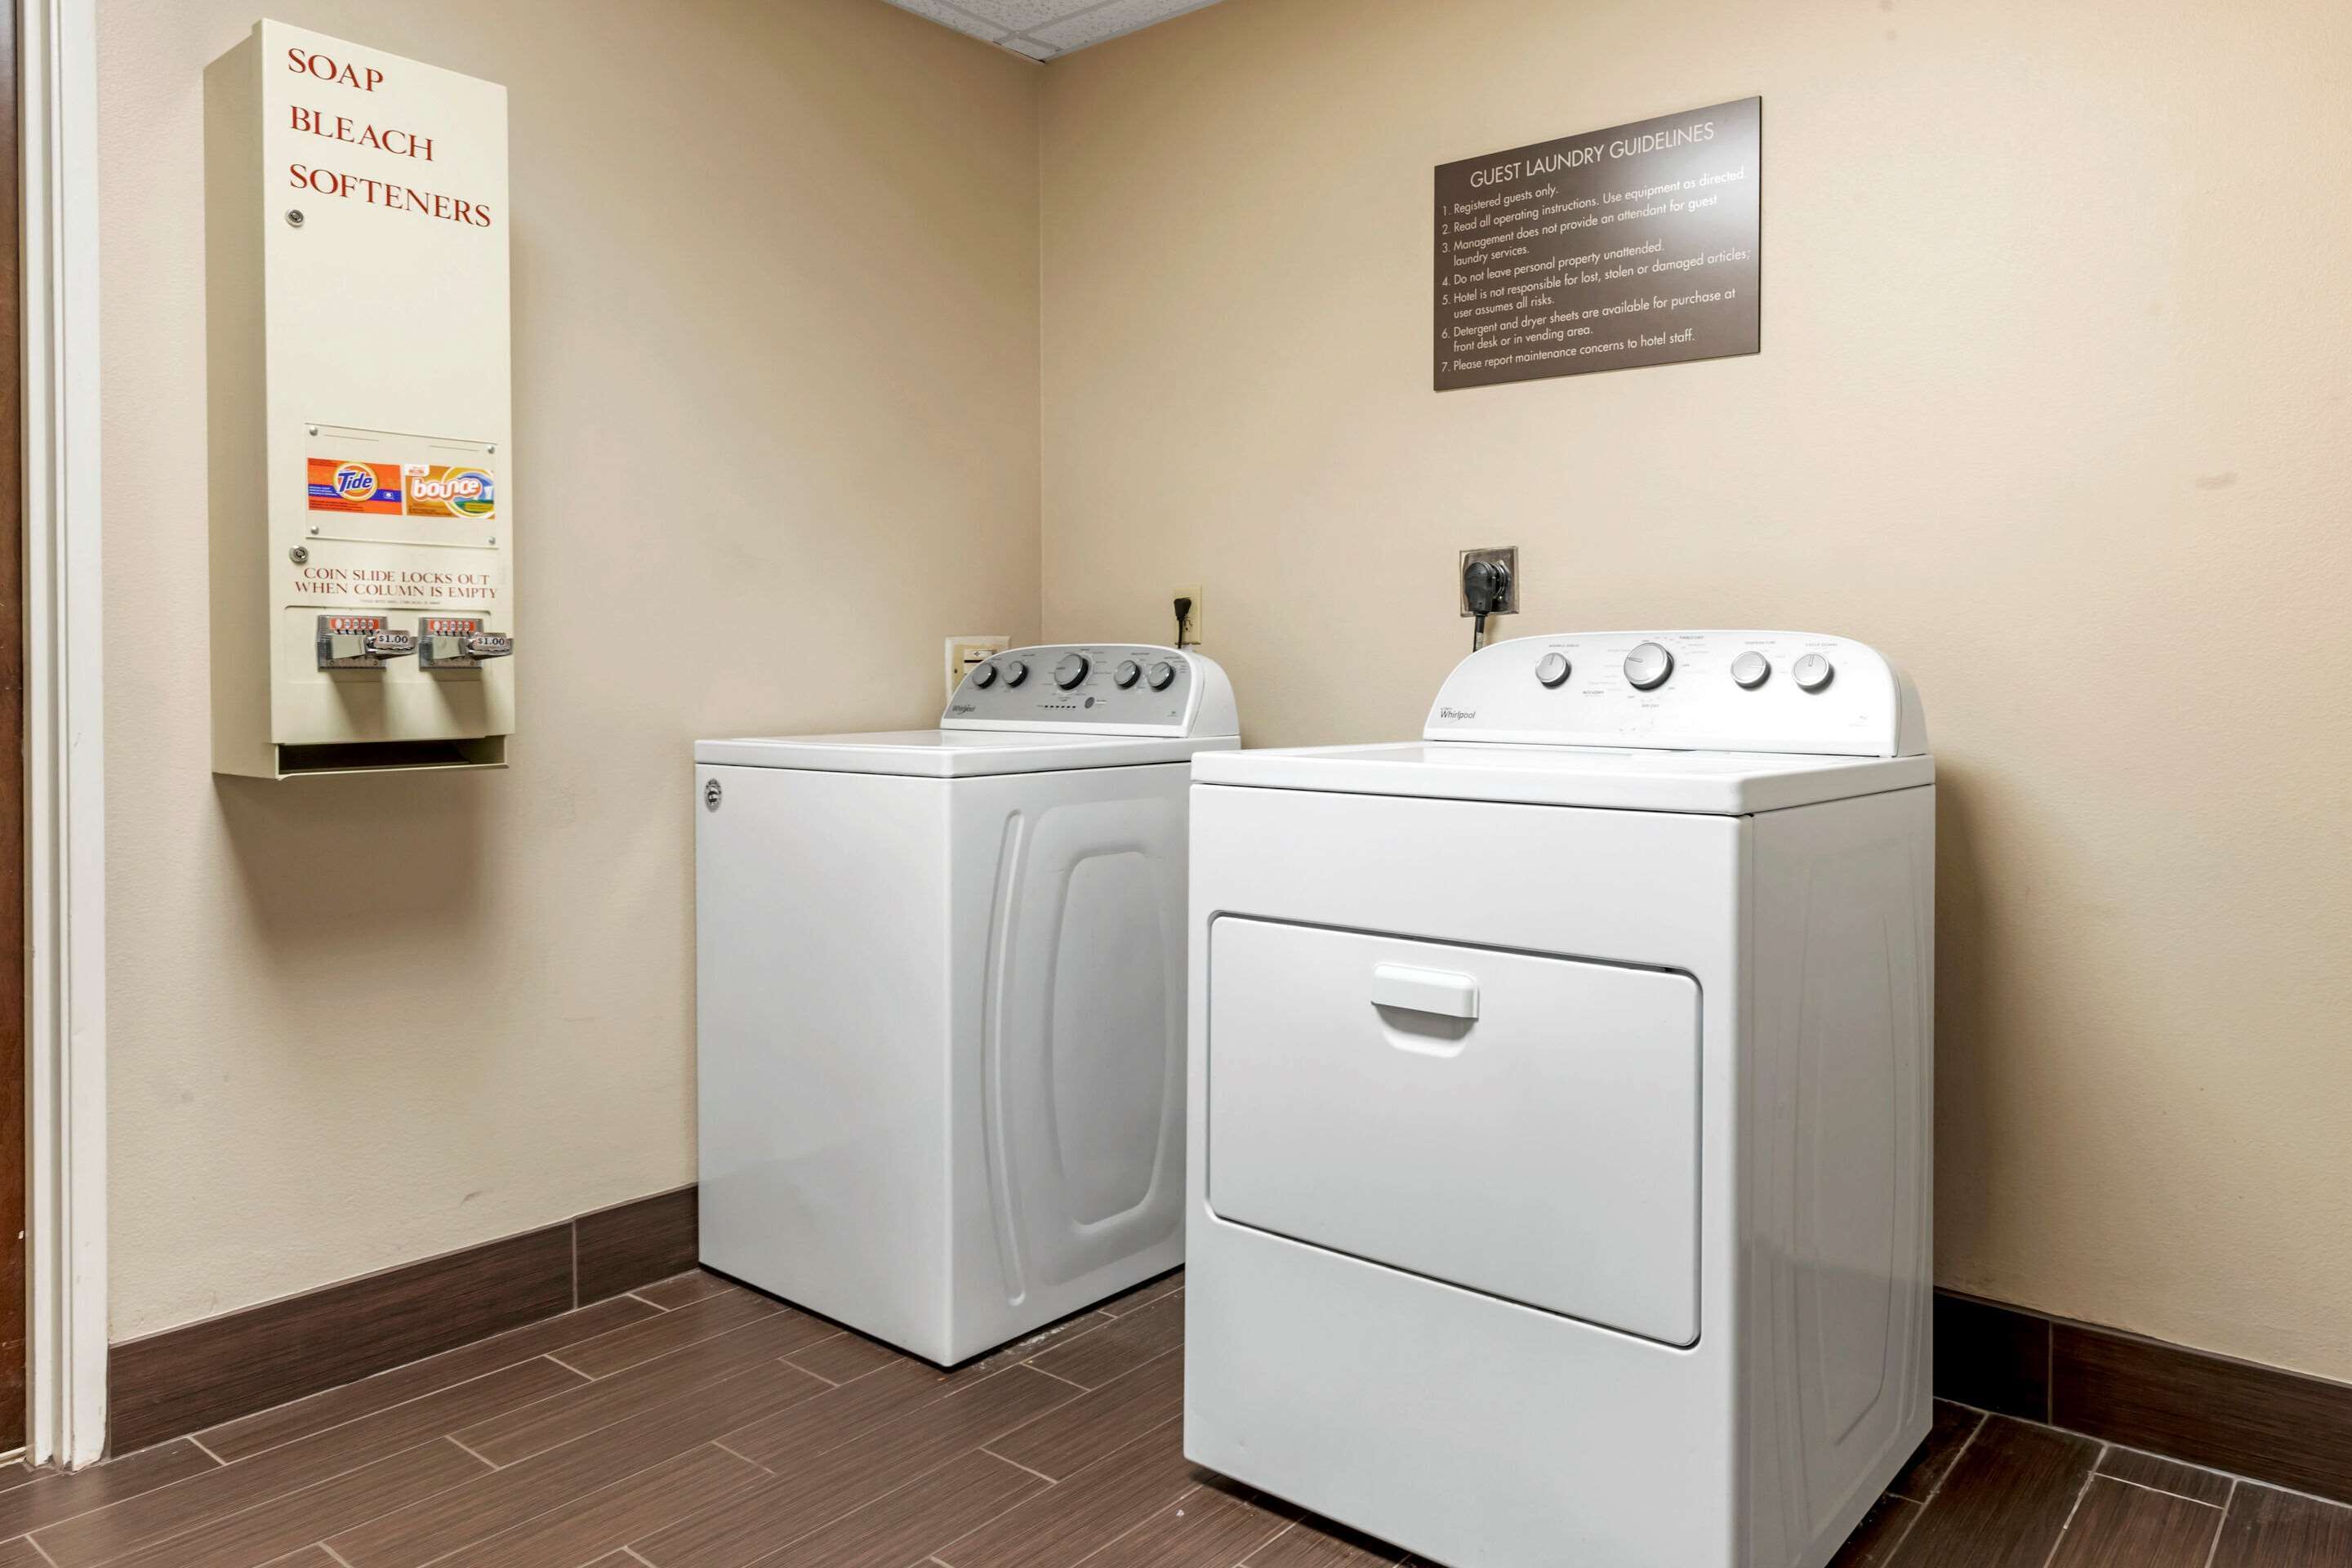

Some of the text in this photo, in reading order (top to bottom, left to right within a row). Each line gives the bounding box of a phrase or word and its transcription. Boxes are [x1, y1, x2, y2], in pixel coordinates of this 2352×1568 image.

[288, 48, 383, 91] SOAP
[290, 105, 434, 162] BLEACH
[1470, 122, 1714, 188] GUEST LAUNDRY GUIDELINES
[290, 163, 491, 228] SOFTENERS
[1442, 166, 1748, 234] 2. Read all operating instructions. Use equipment as directed.
[1443, 183, 1559, 216] 1. Registered guests only.
[1442, 195, 1717, 253] 3. Management does not provide an attendant for guest
[1441, 238, 1665, 286] 4. Do not leave personal property unattended.
[1454, 246, 1530, 266] laundry services.
[1442, 296, 1451, 305] 5.
[1454, 289, 1477, 303] Hotel
[1480, 287, 1487, 299] is
[1490, 287, 1504, 297] not
[1508, 275, 1561, 296] responsible
[1565, 274, 1579, 285] for
[1582, 271, 1601, 283] lost,
[1605, 265, 1633, 280] stolen
[1637, 266, 1649, 274] or
[1653, 253, 1704, 272] damaged
[1441, 288, 1735, 339] 6. Detergent and dryer sheets are available for purchase at
[1454, 293, 1555, 318] user assumes all risks.
[1441, 328, 1695, 372] 7. Please report maintenance concerns to hotel staff.
[1454, 327, 1593, 352] front desk or in vending area.
[338, 471, 373, 492] Tide
[414, 478, 479, 499] bounce
[295, 581, 497, 599] WHEN COLUMN IS EMPTY
[304, 568, 490, 585] COIN SLIDE LOCKS OUT
[379, 635, 408, 644] $1.00
[478, 637, 505, 646] $1.00
[1440, 710, 1477, 720] Whirlpool
